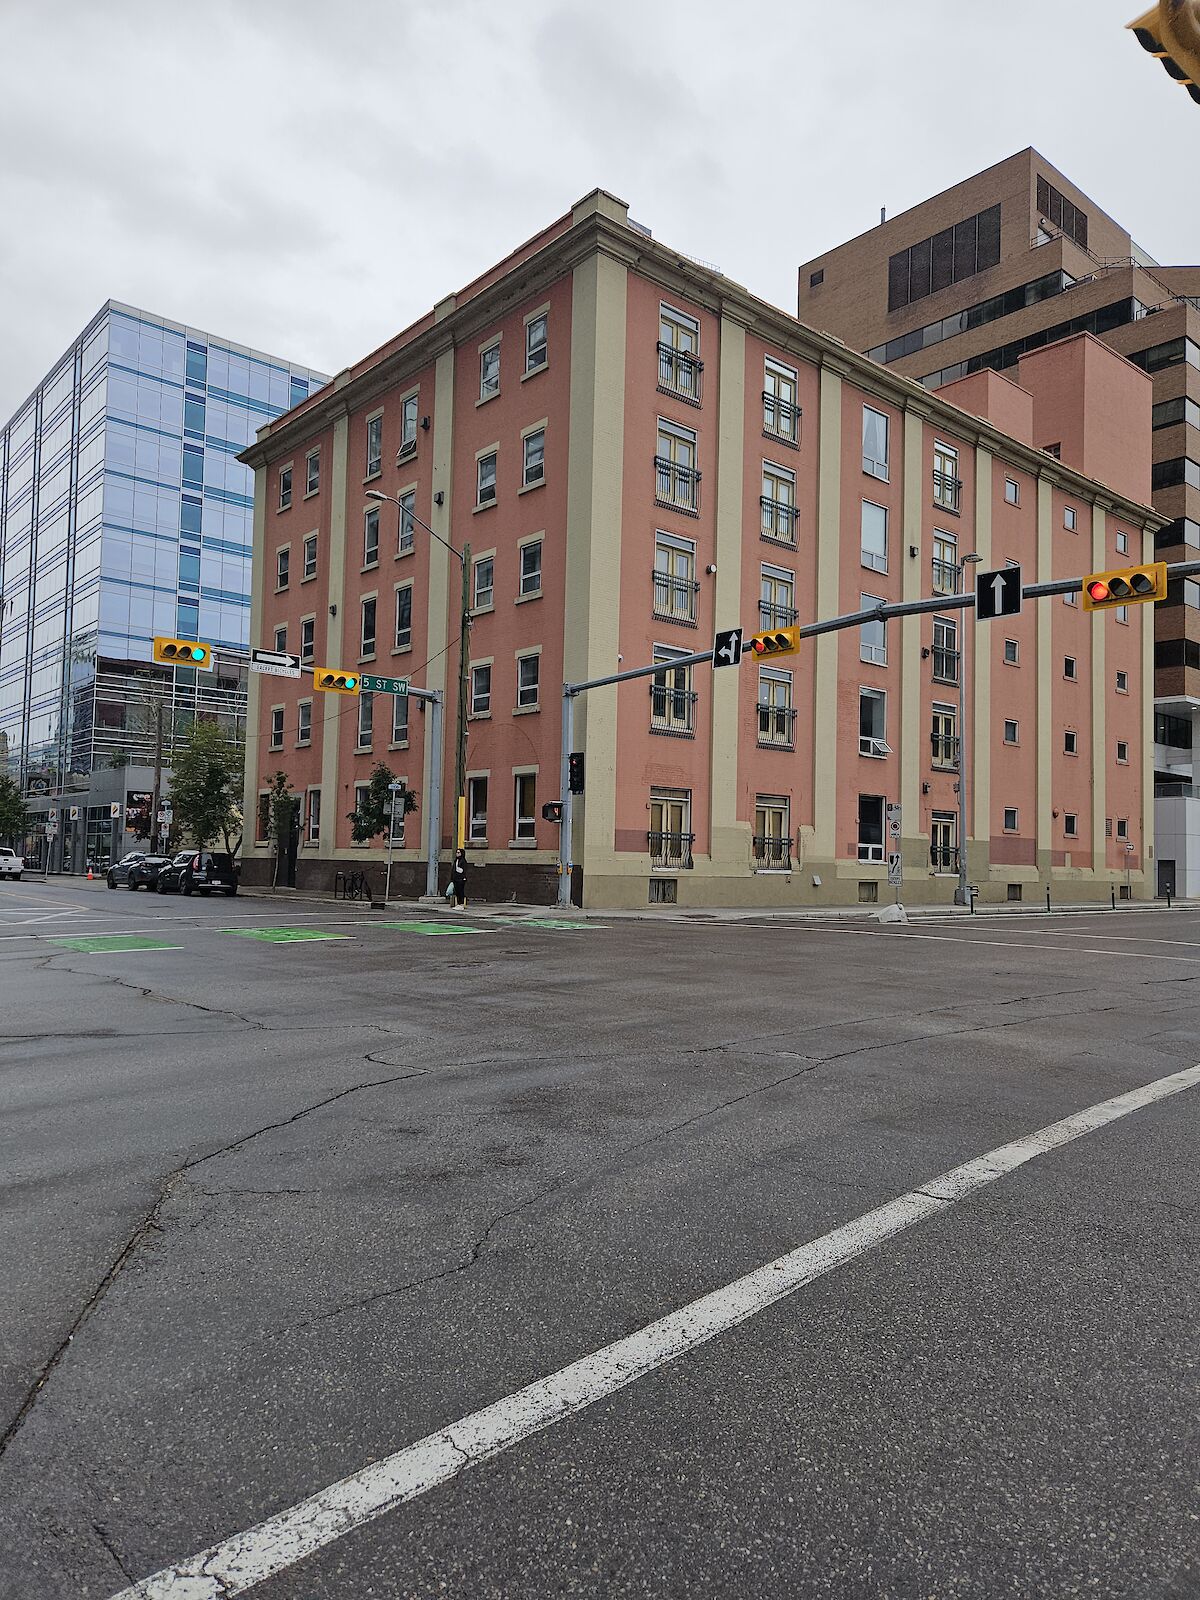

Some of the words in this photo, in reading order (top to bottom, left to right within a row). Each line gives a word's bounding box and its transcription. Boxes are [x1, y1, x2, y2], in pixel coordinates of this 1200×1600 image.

[363, 677, 370, 687] 5
[375, 679, 388, 690] ST
[392, 682, 406, 693] SW
